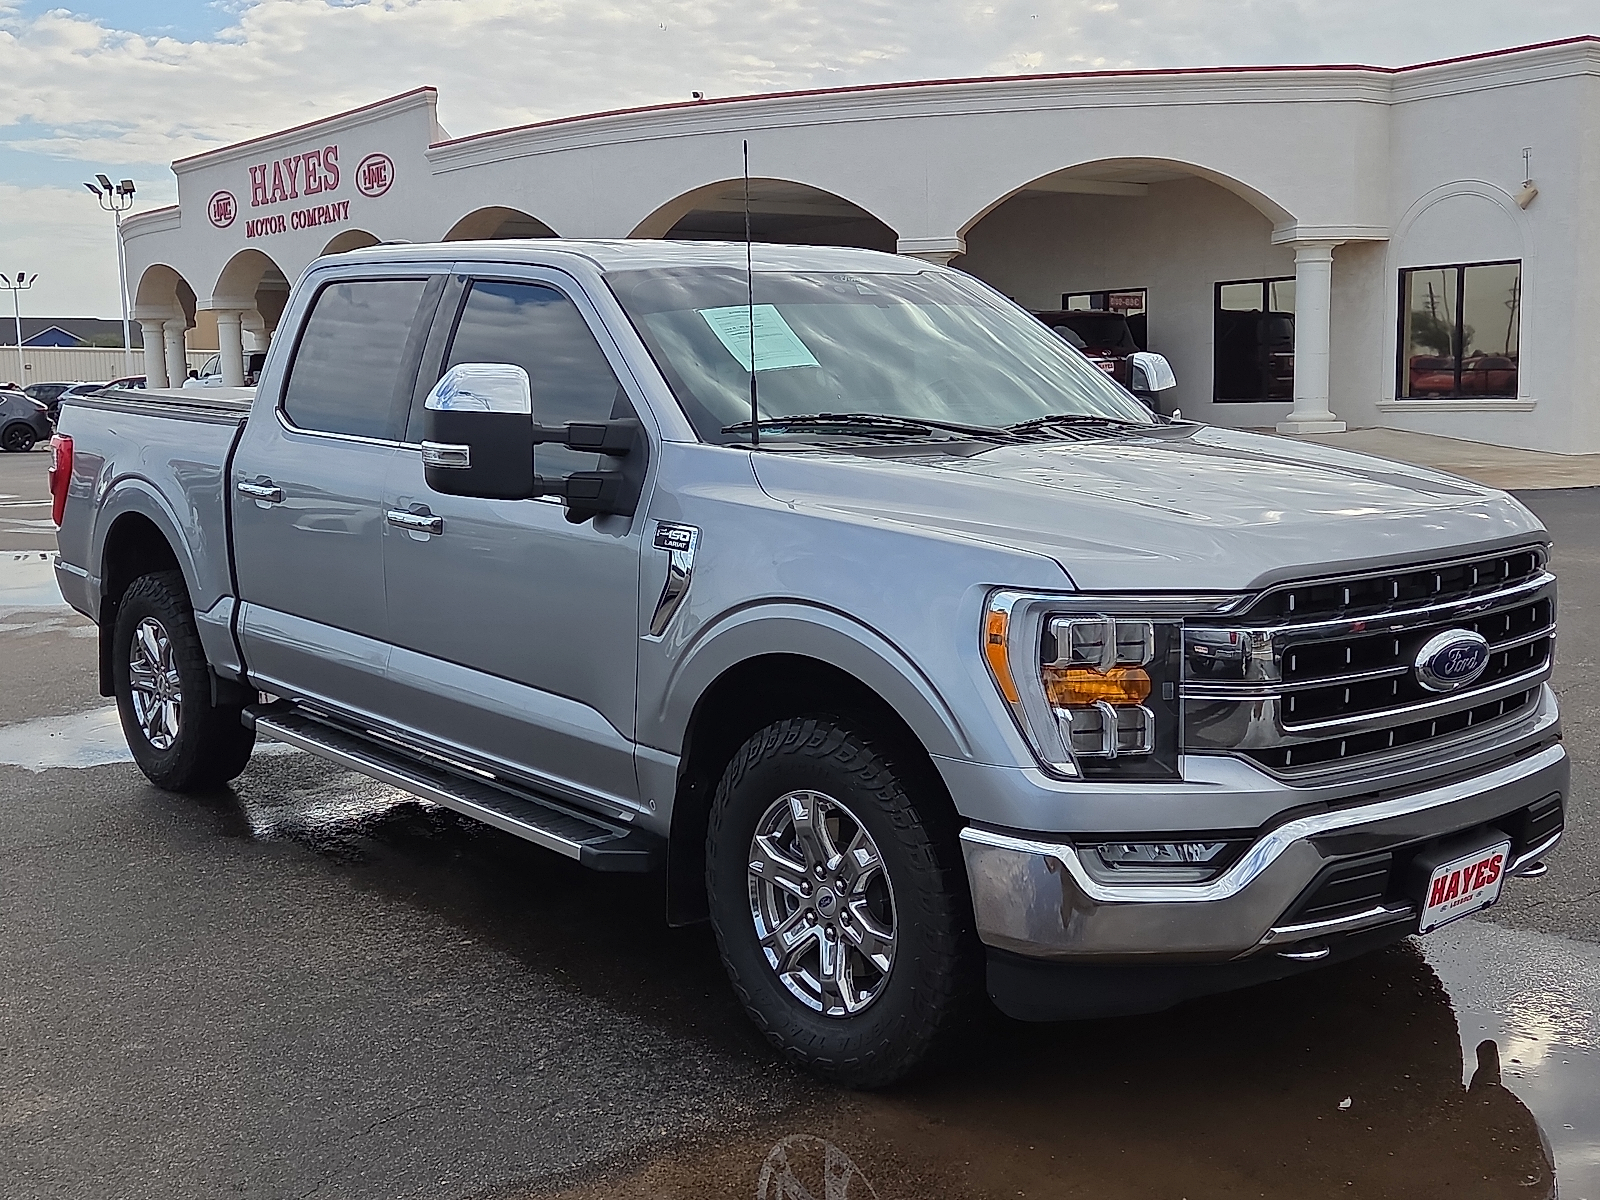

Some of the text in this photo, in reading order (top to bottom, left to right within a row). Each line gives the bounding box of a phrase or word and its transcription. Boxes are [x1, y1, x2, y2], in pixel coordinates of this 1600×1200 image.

[248, 145, 340, 207] HAYES
[246, 200, 350, 238] MOTOR COMPANY
[657, 528, 690, 541] F-150
[664, 540, 686, 548] LARIAT
[1445, 646, 1479, 675] Ford
[1428, 854, 1504, 908] HAYES
